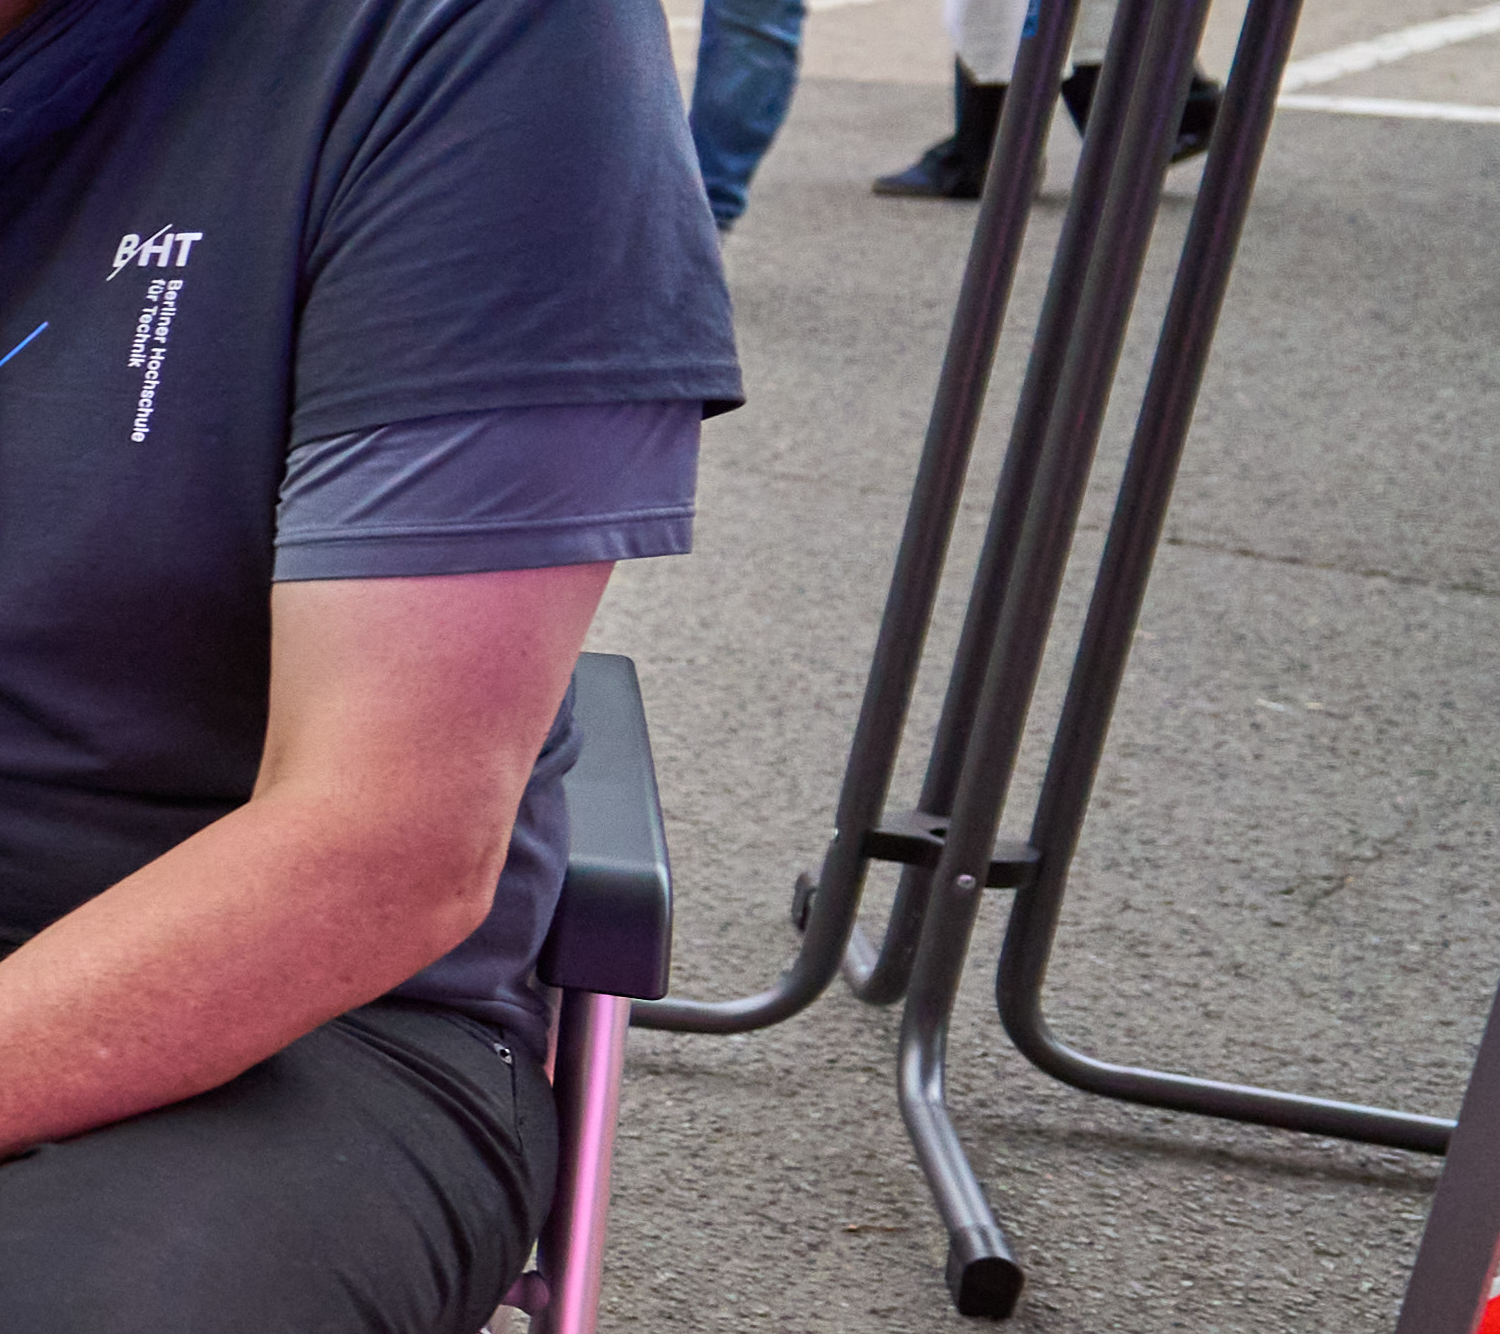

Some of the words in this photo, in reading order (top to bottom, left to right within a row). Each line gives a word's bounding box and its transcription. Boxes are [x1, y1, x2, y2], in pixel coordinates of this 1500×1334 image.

[108, 227, 203, 274] BHT
[146, 279, 166, 301] für
[153, 279, 183, 344] Berliner
[127, 305, 158, 368] Technik
[131, 348, 167, 443] Hochschule
